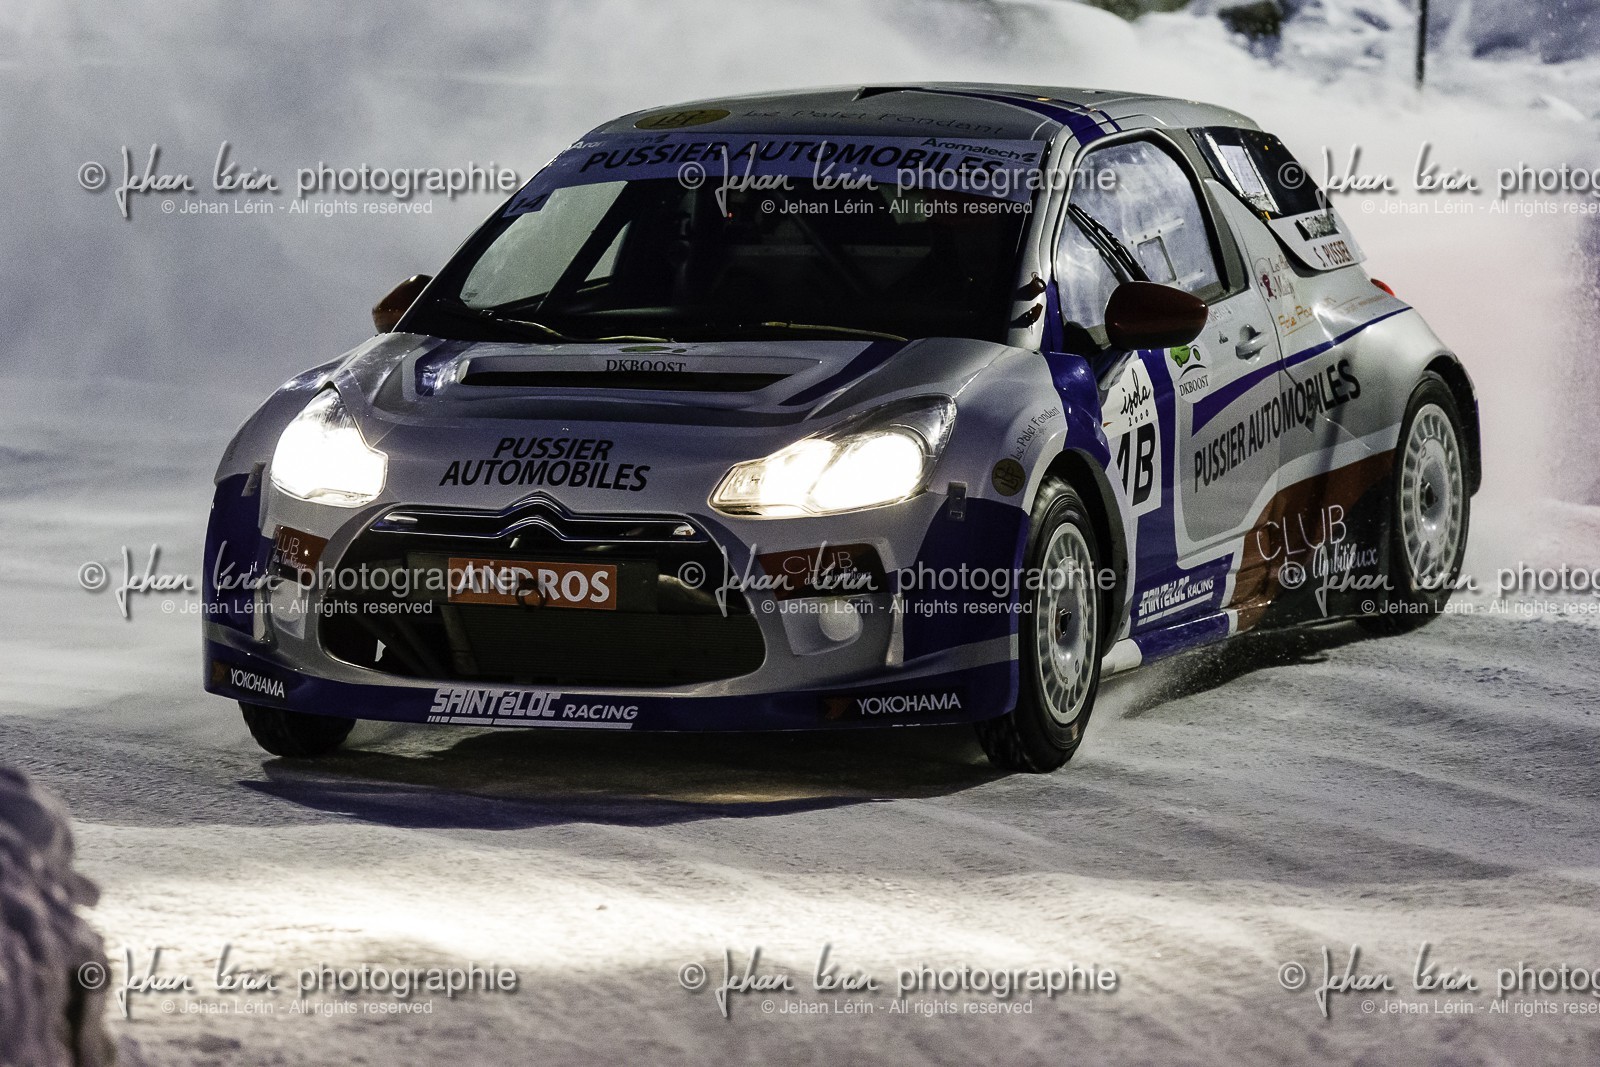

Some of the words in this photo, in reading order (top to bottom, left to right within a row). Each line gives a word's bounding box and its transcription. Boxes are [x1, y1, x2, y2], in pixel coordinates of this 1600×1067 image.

[579, 140, 729, 173] PUSSIER
[728, 139, 1007, 183] AUTOMOBILES
[921, 137, 1021, 161] Aromatech
[605, 358, 687, 374] DKBOOST
[1178, 374, 1210, 397] DKBOOST
[1193, 420, 1247, 494] PUSSIER
[1247, 358, 1362, 458] AUTOMOBILES
[492, 436, 614, 461] PUSSIER
[438, 458, 651, 492] AUTOMOBILES
[1256, 504, 1347, 561] CLUB
[782, 550, 853, 575] CLUB
[455, 563, 611, 604] ANDROS
[1187, 575, 1215, 599] RACING
[230, 667, 286, 699] YOKOHAMA
[562, 703, 639, 720] RACING
[856, 691, 962, 715] YOKOHAMA
